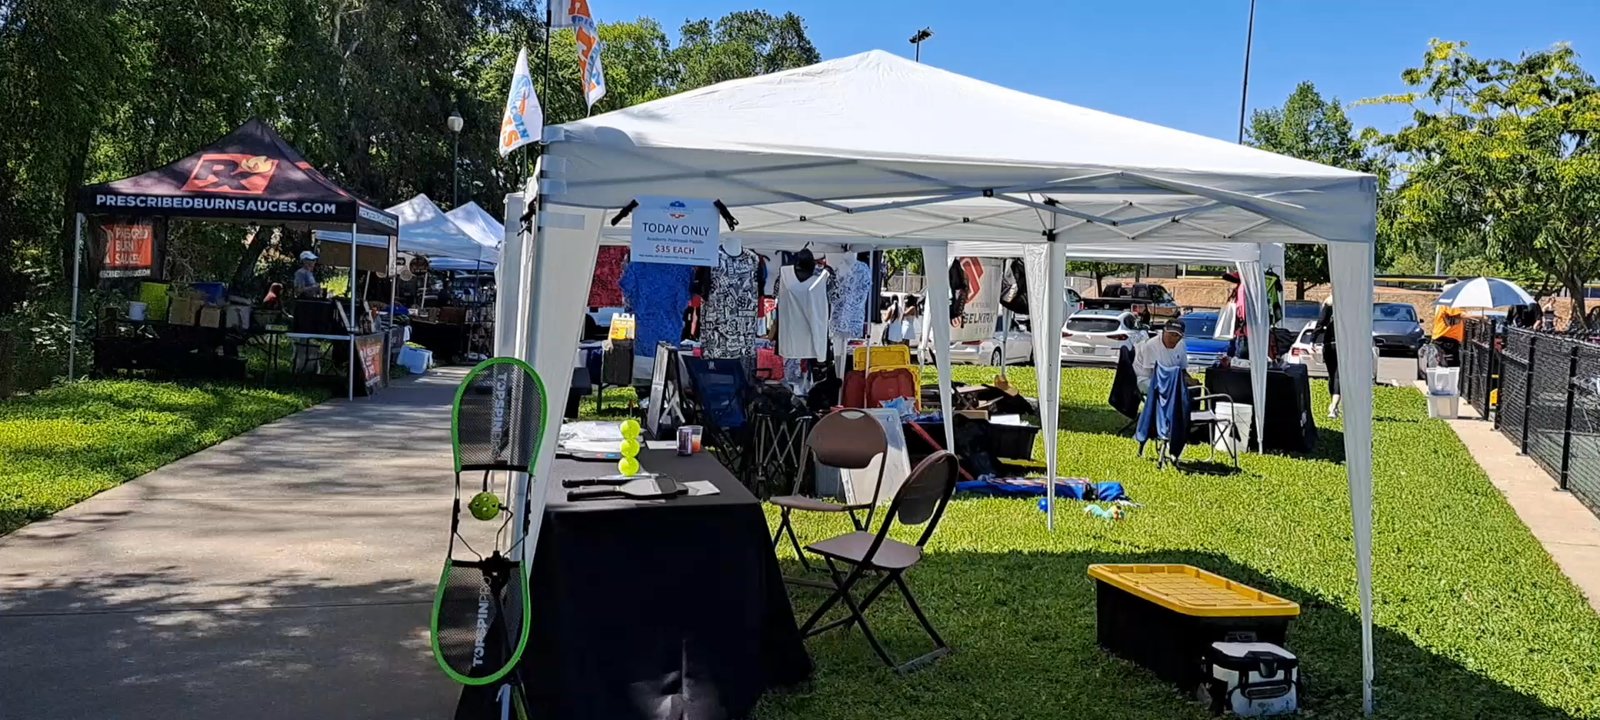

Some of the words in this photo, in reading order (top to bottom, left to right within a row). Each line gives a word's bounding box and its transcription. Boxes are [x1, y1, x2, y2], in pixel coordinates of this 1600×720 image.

[96, 194, 337, 215] PRESCRIBEDBURNSAUCES.COM
[642, 222, 679, 235] TODAY
[681, 225, 709, 237] ONLY
[655, 244, 671, 254] $35
[673, 246, 695, 255] EACH
